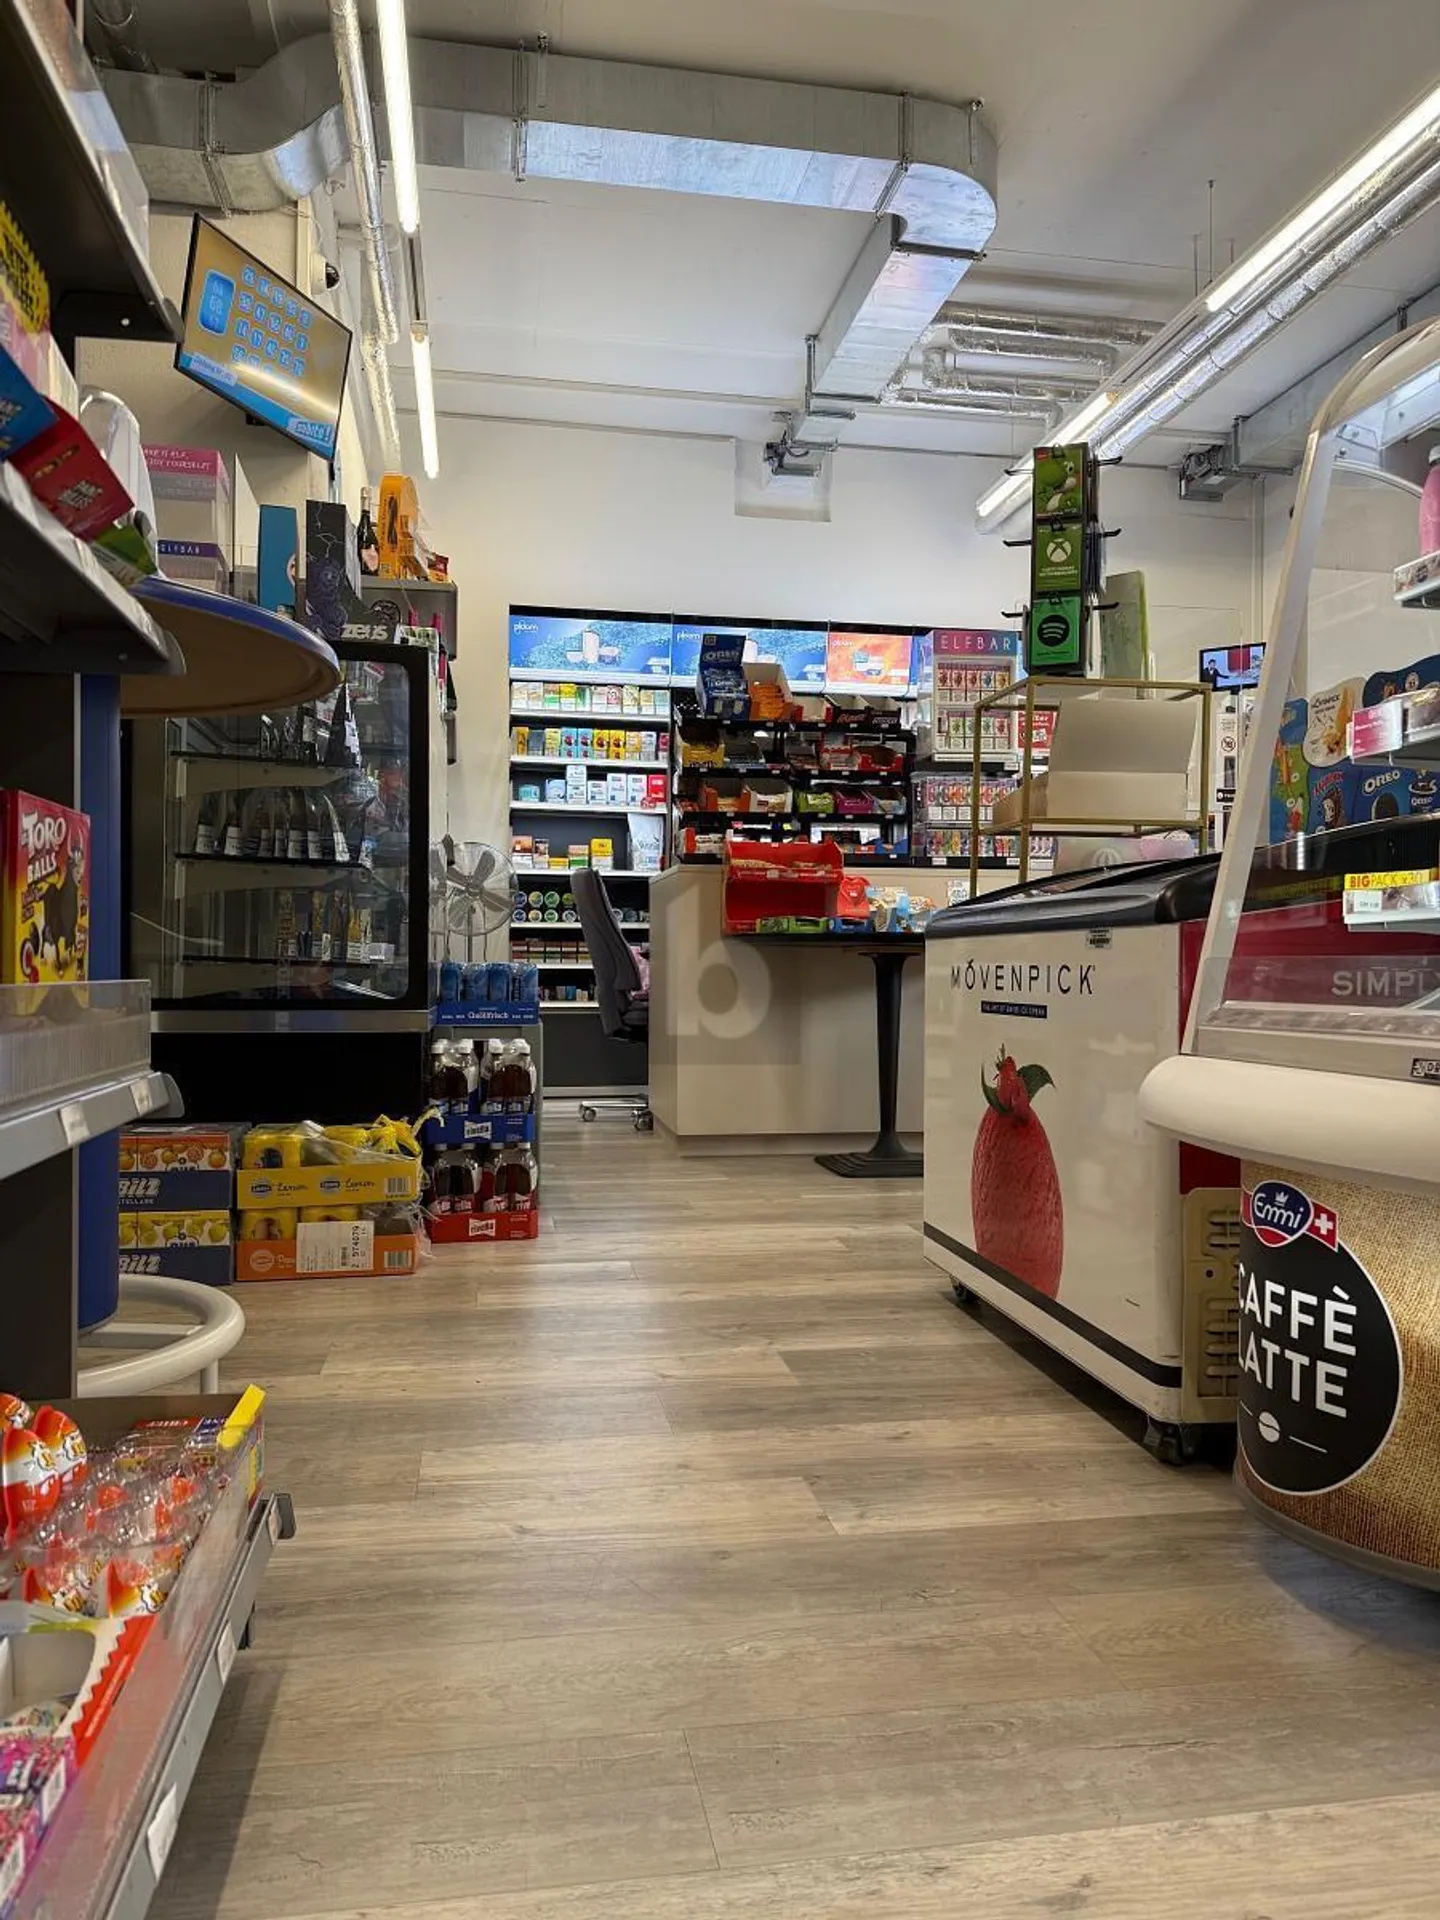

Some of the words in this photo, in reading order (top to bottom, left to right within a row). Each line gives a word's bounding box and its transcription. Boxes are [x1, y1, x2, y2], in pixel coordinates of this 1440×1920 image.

[340, 623, 389, 640] ZEUS
[513, 620, 539, 634] ploom
[941, 635, 1011, 650] ELFBAR
[1363, 769, 1401, 796] OREO
[21, 811, 66, 855] TORO
[27, 851, 57, 882] BALLS
[1350, 875, 1370, 888] BIG
[1254, 1193, 1302, 1229] Emmi
[1238, 1263, 1357, 1356] CAFFÈ
[1238, 1319, 1348, 1418] LATTE
